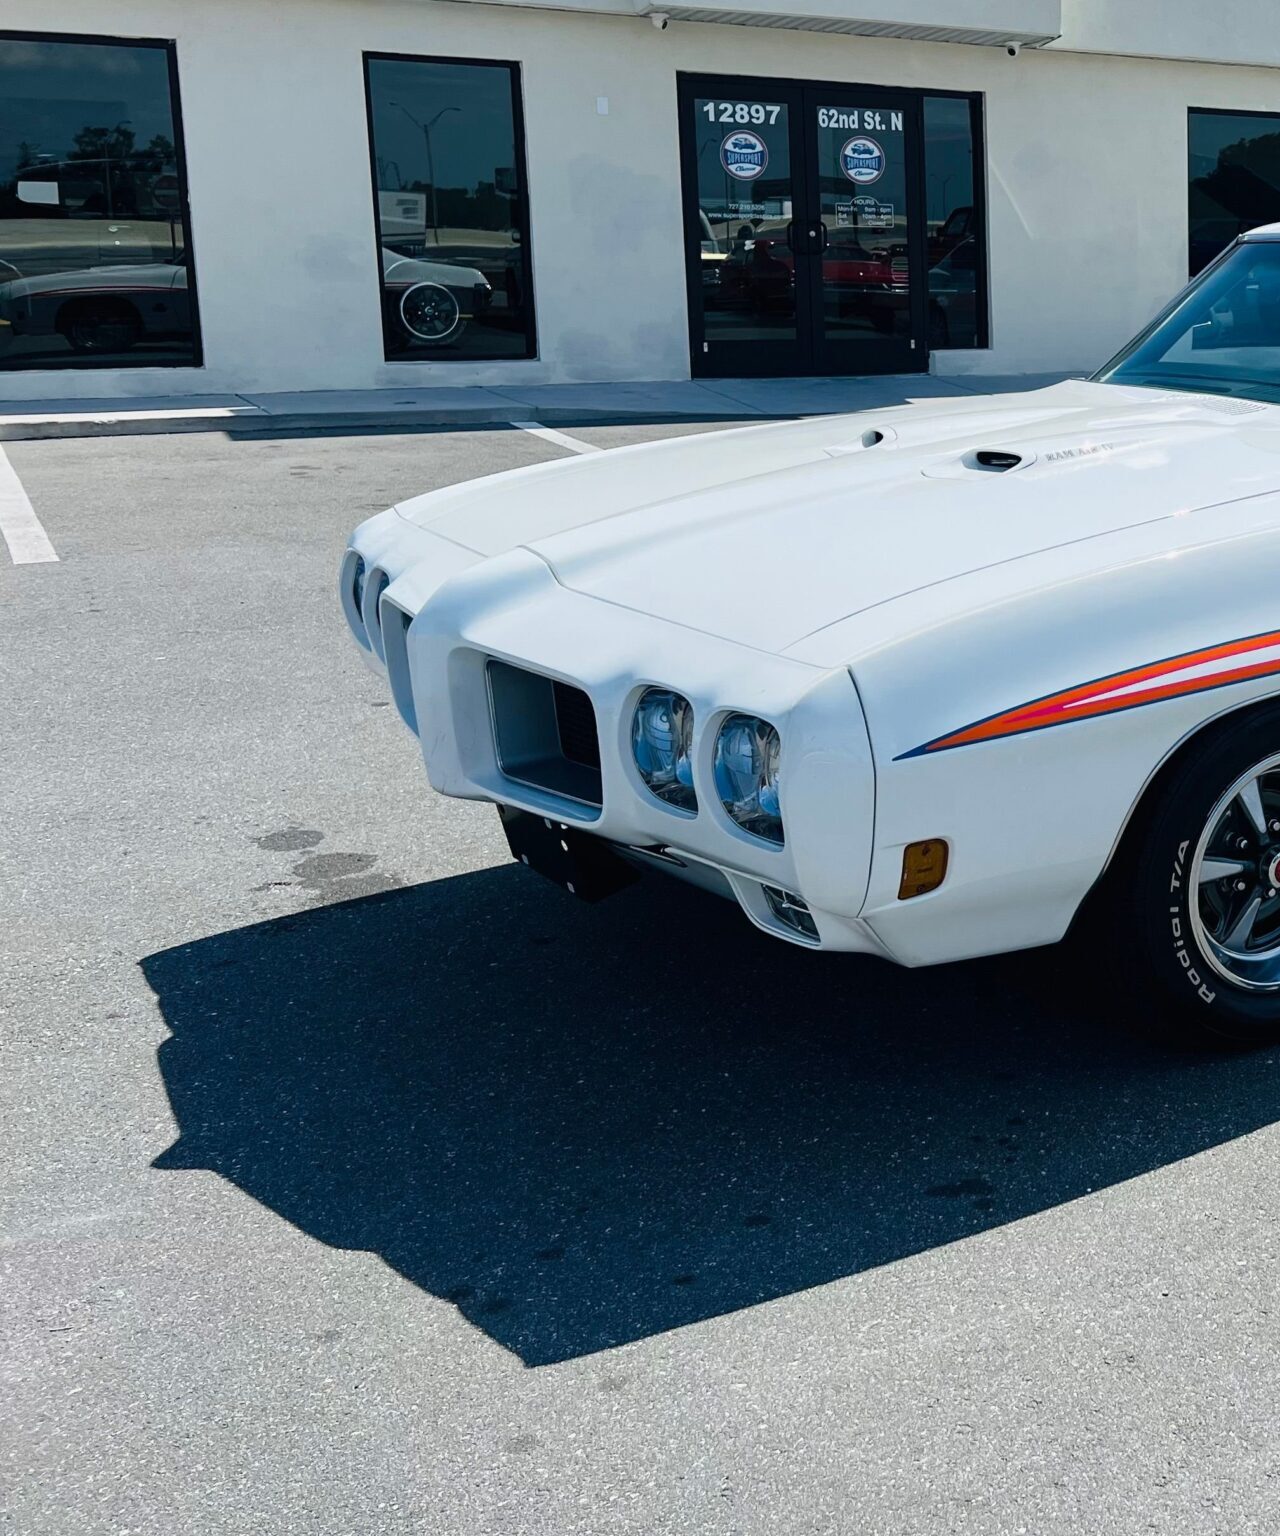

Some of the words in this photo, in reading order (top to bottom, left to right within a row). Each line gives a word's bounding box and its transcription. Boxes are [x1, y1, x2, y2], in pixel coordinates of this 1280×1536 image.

[703, 102, 781, 125] 12897
[818, 108, 859, 129] 62nd
[863, 110, 886, 131] St.
[890, 112, 903, 131] N
[727, 151, 761, 165] SUPERSPORT
[847, 156, 879, 170] SUPERSPORT
[1170, 839, 1190, 893] T/A
[1169, 906, 1217, 1004] Radial
